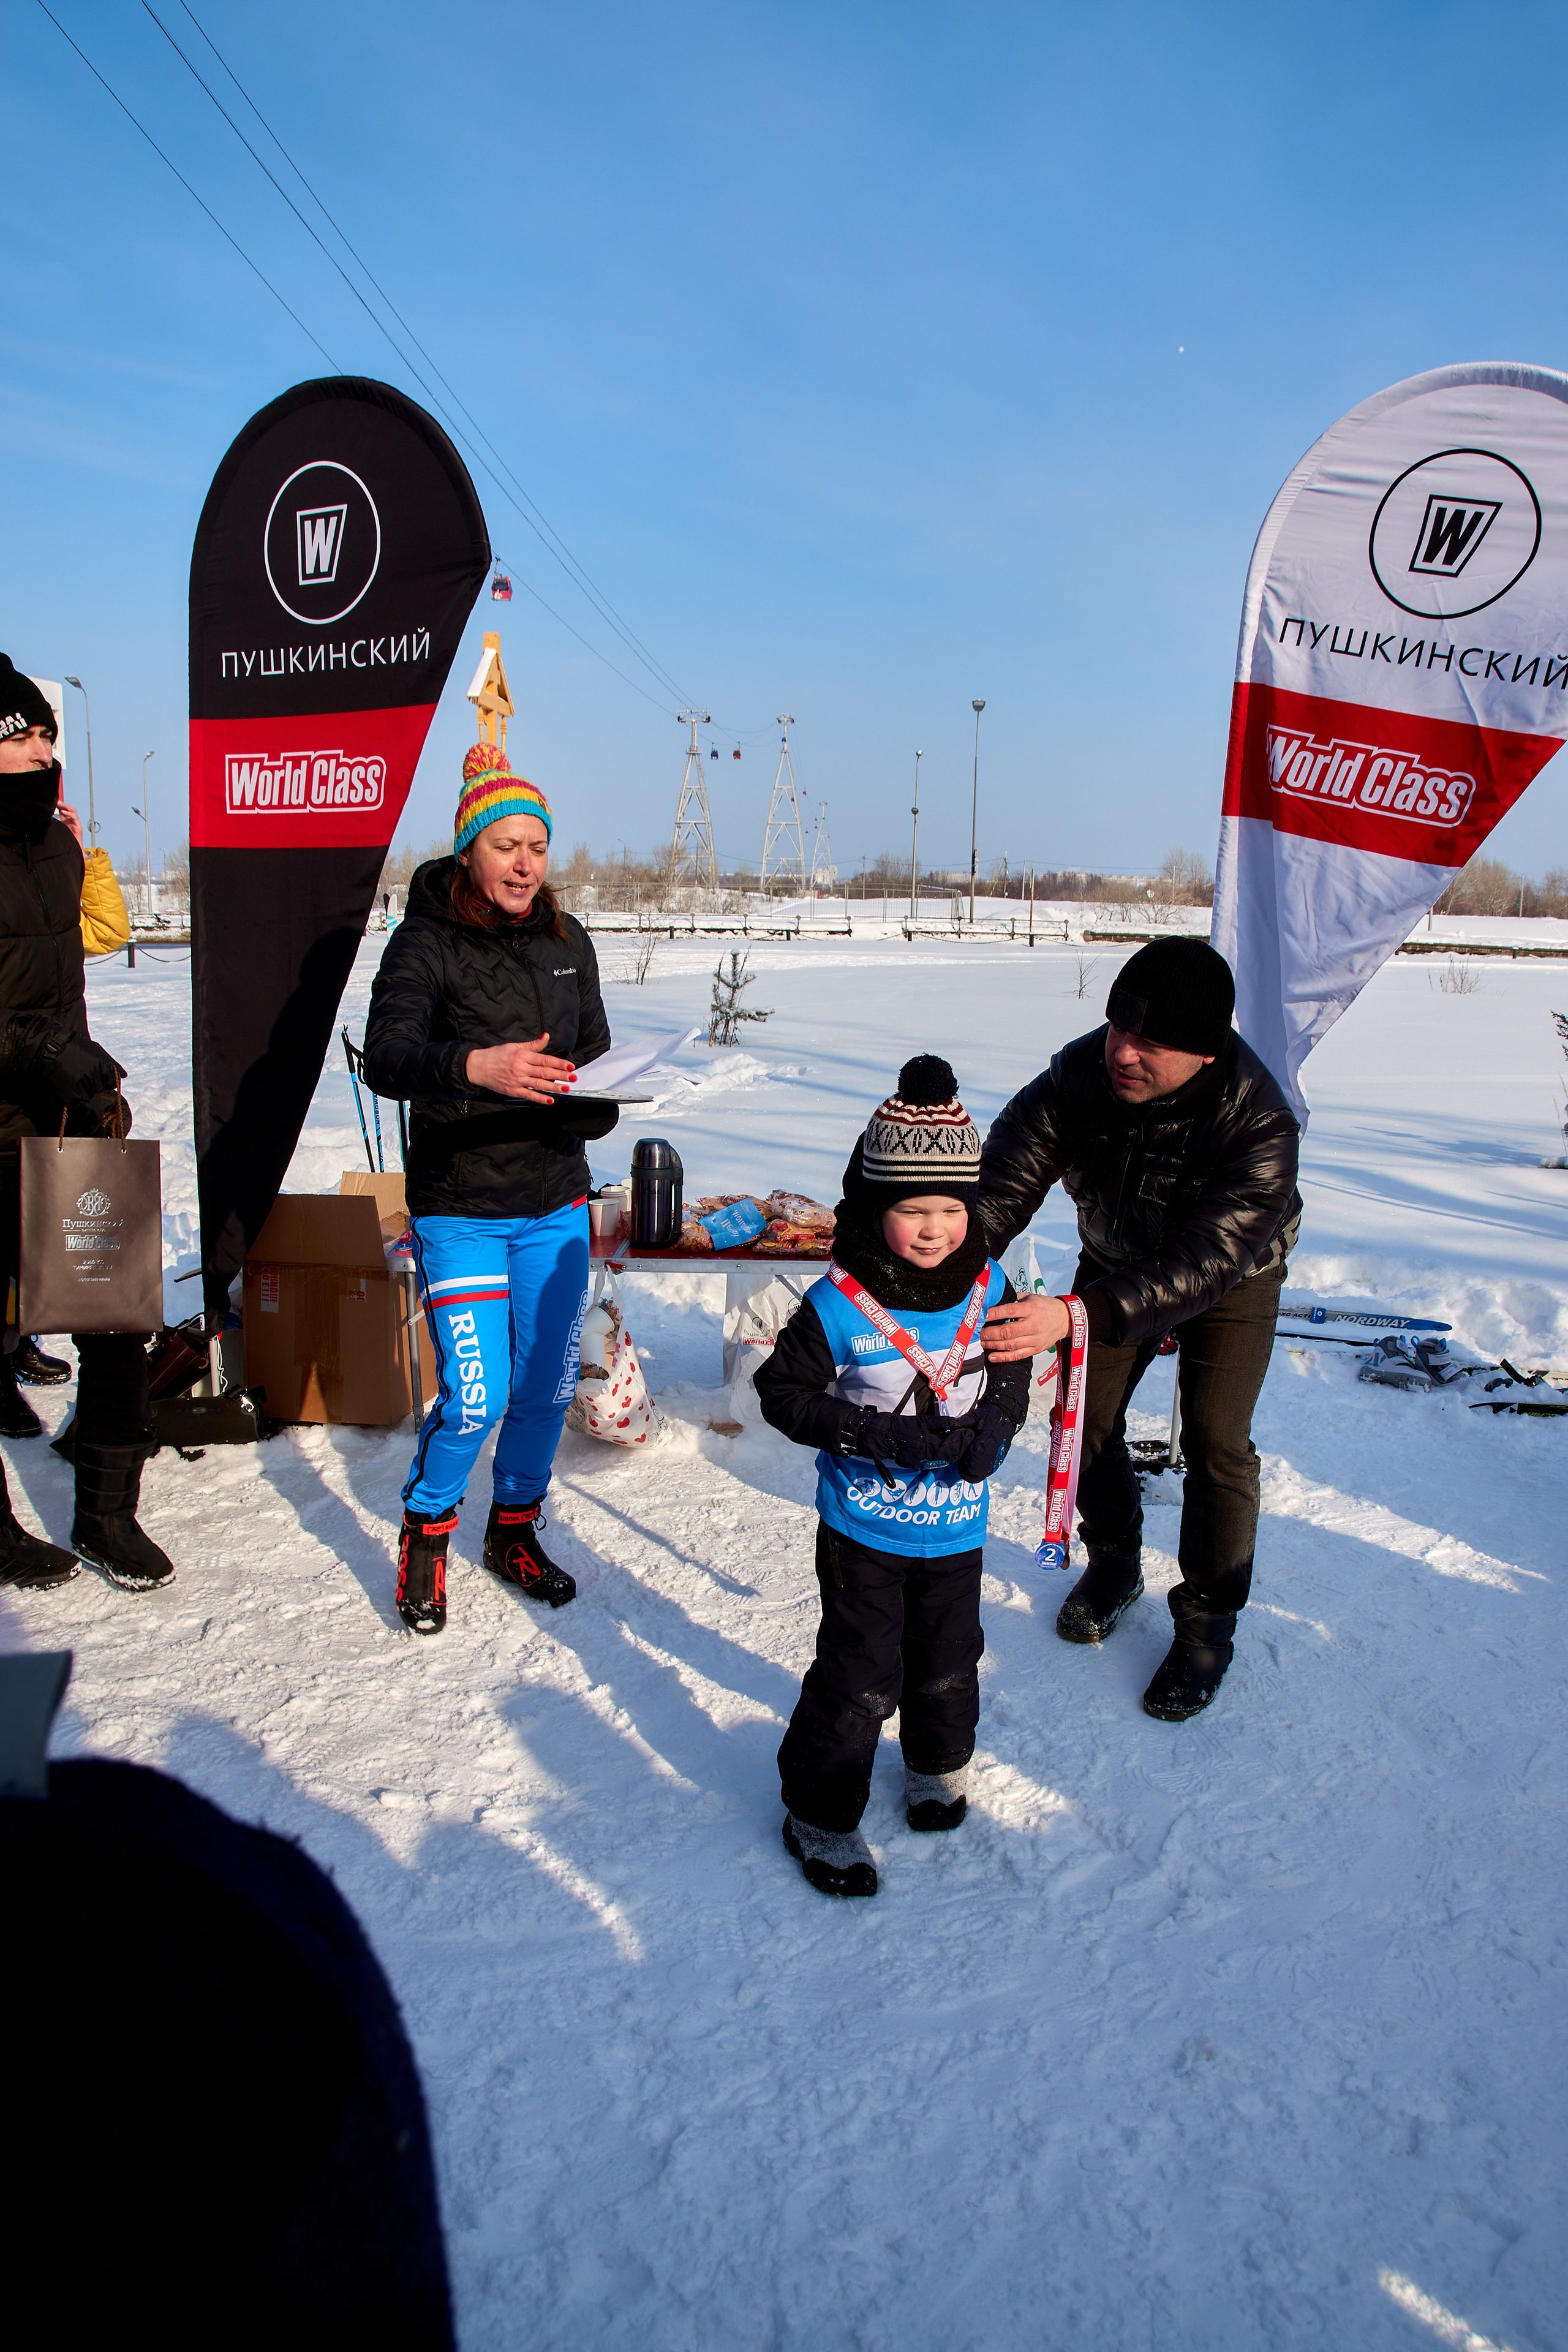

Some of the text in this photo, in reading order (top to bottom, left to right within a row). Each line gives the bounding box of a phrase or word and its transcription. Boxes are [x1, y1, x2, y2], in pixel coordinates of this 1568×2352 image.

[304, 517, 337, 575] W
[1422, 506, 1485, 566] W
[221, 628, 431, 678] ПУШКИНСКИЙ
[1279, 617, 1568, 691] ПУШКИНСКИЙ
[231, 758, 381, 807] World Class
[1268, 732, 1468, 822] World Class
[67, 1237, 94, 1249] World
[856, 1292, 898, 1335] World Class
[967, 1283, 984, 1327] World Class
[1070, 1302, 1085, 1346] World Class
[1333, 1314, 1412, 1328] NORDWAY
[854, 1334, 886, 1353] World
[908, 1346, 930, 1368] Class
[938, 1343, 965, 1386] World Class
[448, 1310, 486, 1435] RUSSIA
[1068, 1366, 1082, 1410] World Class
[1059, 1429, 1072, 1471] World Class
[846, 1486, 981, 1525] OUTDOOR TEAM
[1049, 1512, 1061, 1531] Class
[1052, 1490, 1065, 1512] World
[1044, 1548, 1056, 1562] 2
